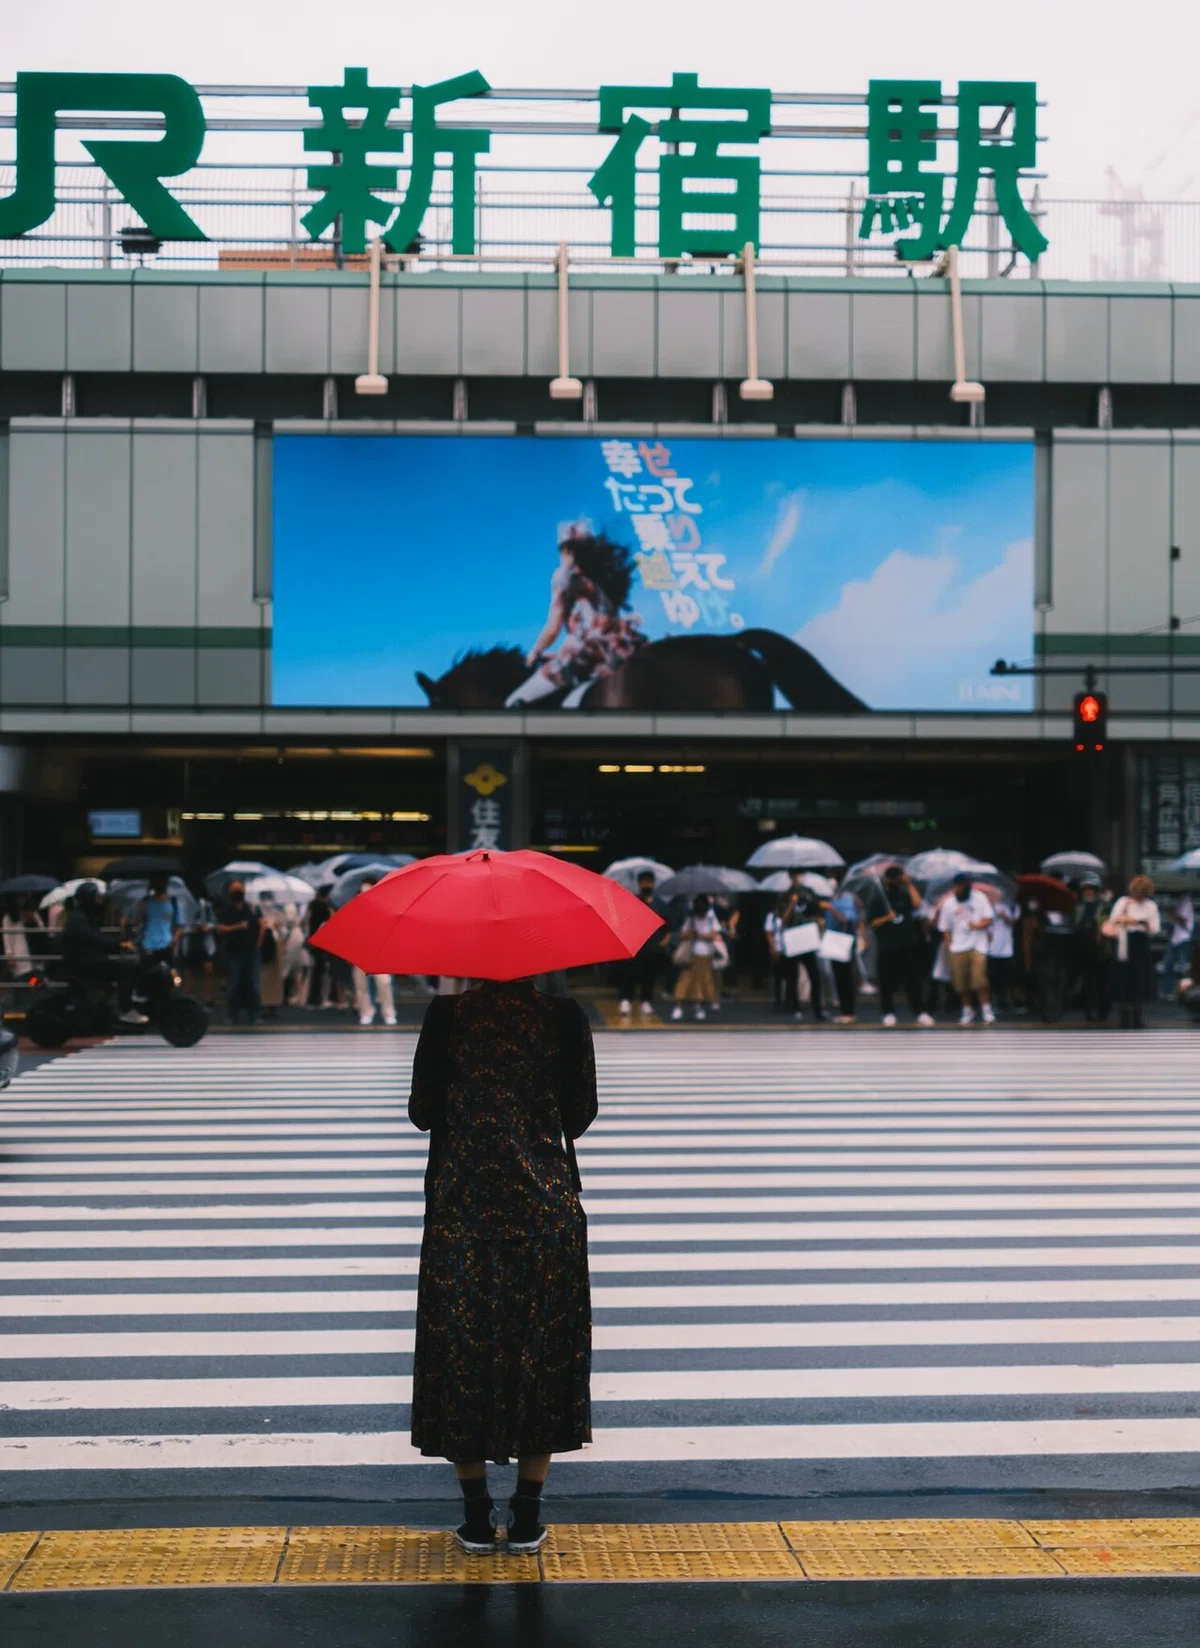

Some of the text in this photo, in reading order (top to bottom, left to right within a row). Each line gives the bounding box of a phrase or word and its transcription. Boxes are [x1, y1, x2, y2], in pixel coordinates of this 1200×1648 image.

[0, 67, 1049, 263] JR 新宿駅
[601, 440, 677, 478] 幸せ
